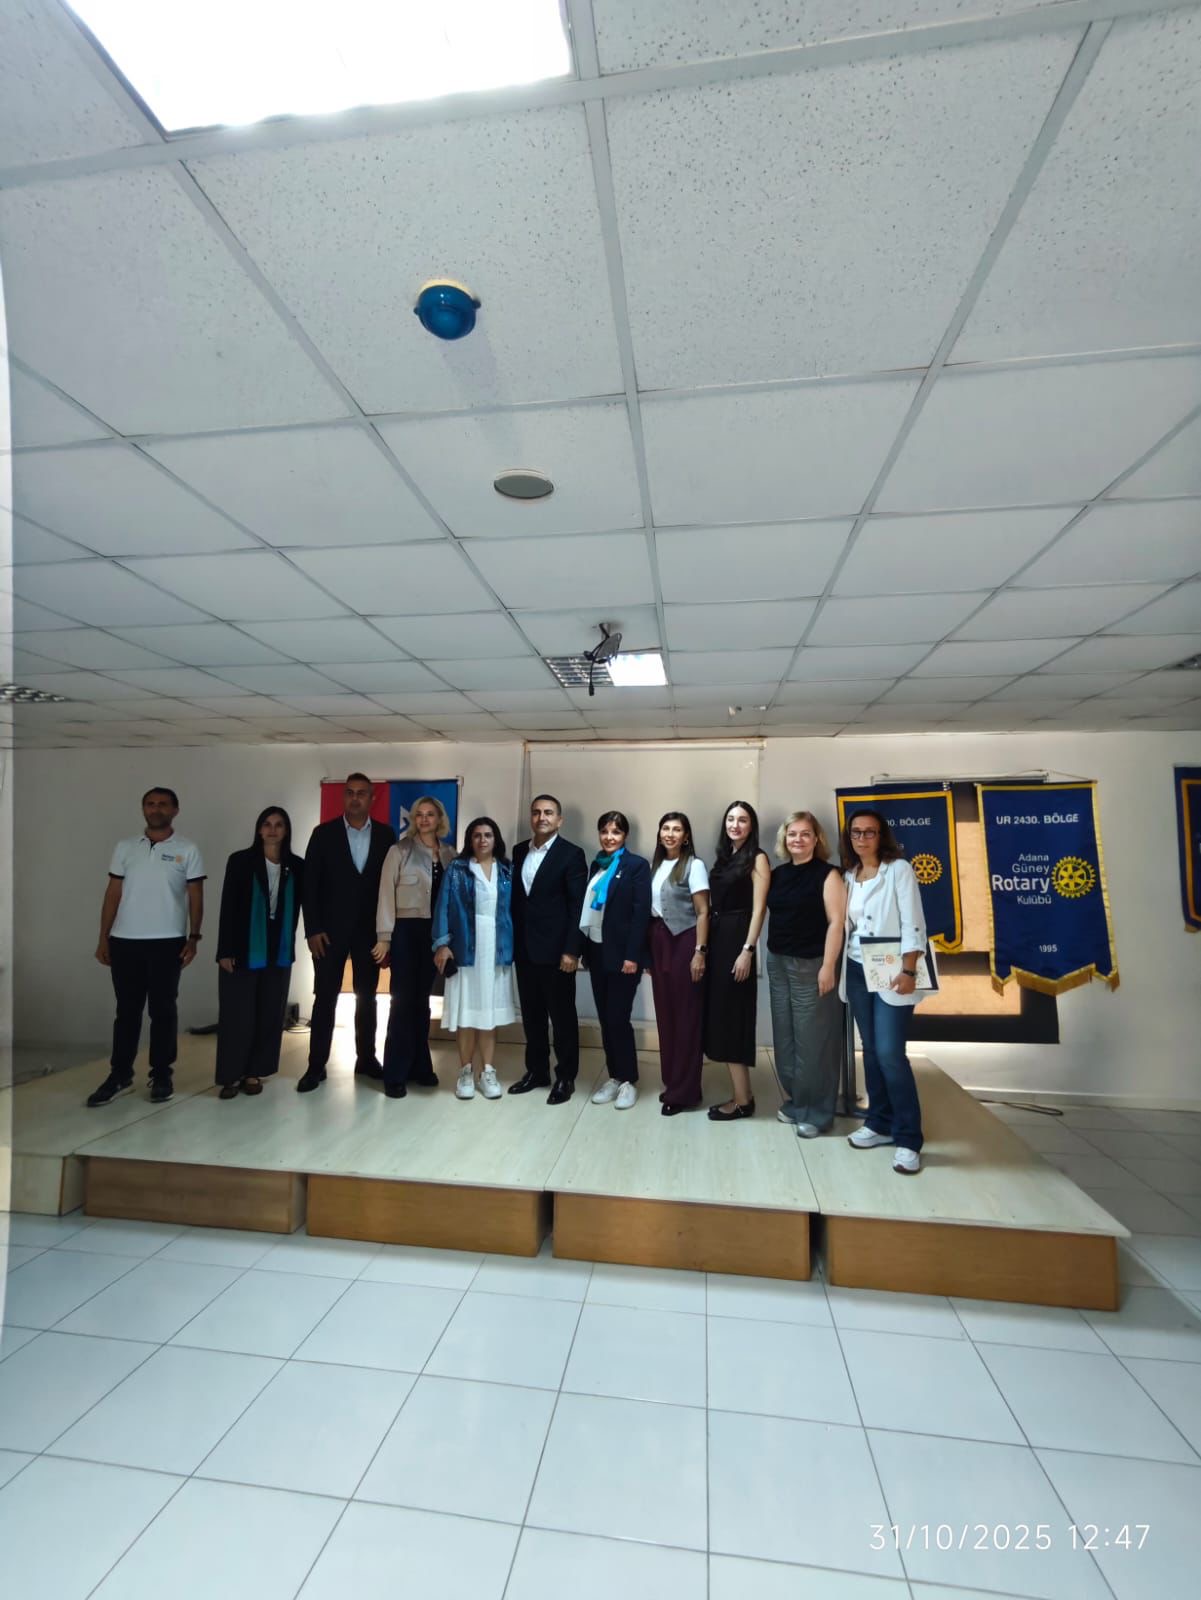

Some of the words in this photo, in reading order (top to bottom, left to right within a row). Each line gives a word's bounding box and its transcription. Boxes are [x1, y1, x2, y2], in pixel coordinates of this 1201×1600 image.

[900, 817, 931, 826] BÖLGE
[996, 815, 1011, 824] UR
[1014, 815, 1040, 824] 2430.
[1044, 813, 1079, 824] BÖLGE
[1018, 853, 1049, 862] Adana
[1012, 863, 1050, 874] Güney
[991, 874, 1050, 893] Rotary
[1017, 895, 1052, 905] Kulübü
[1039, 944, 1058, 952] 1995
